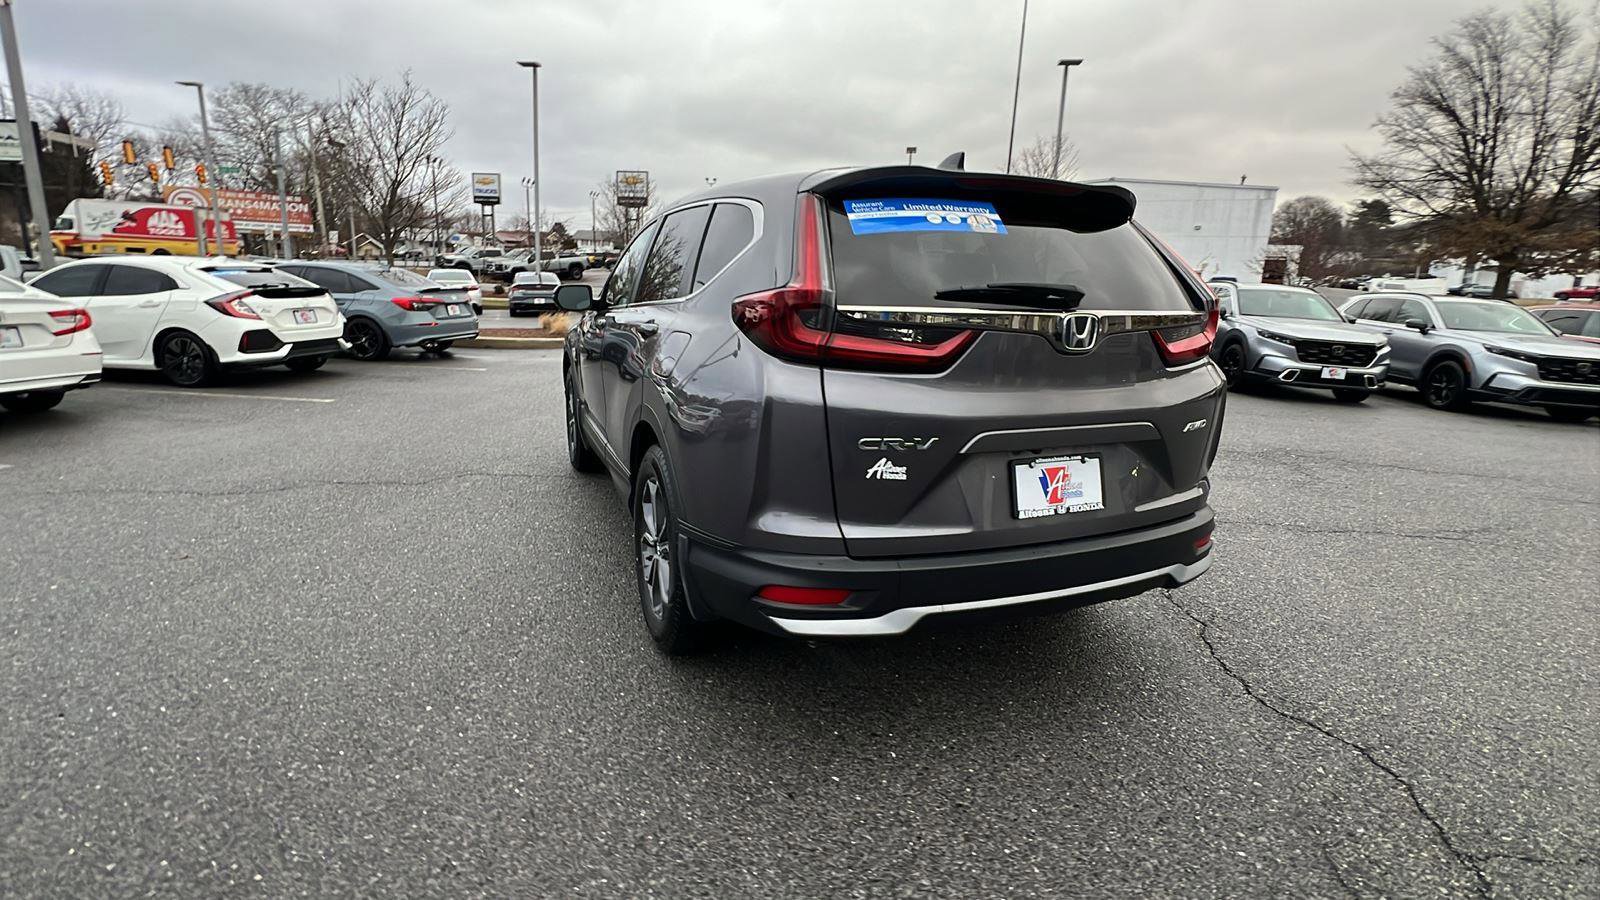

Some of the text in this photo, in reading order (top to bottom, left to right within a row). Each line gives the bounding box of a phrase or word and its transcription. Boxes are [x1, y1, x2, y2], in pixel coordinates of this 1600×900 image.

[210, 198, 309, 213] RANS4MAION
[902, 203, 990, 215] Limited Warranty
[858, 437, 939, 451] CR-V
[1018, 502, 1104, 519] Altoona HONDA
